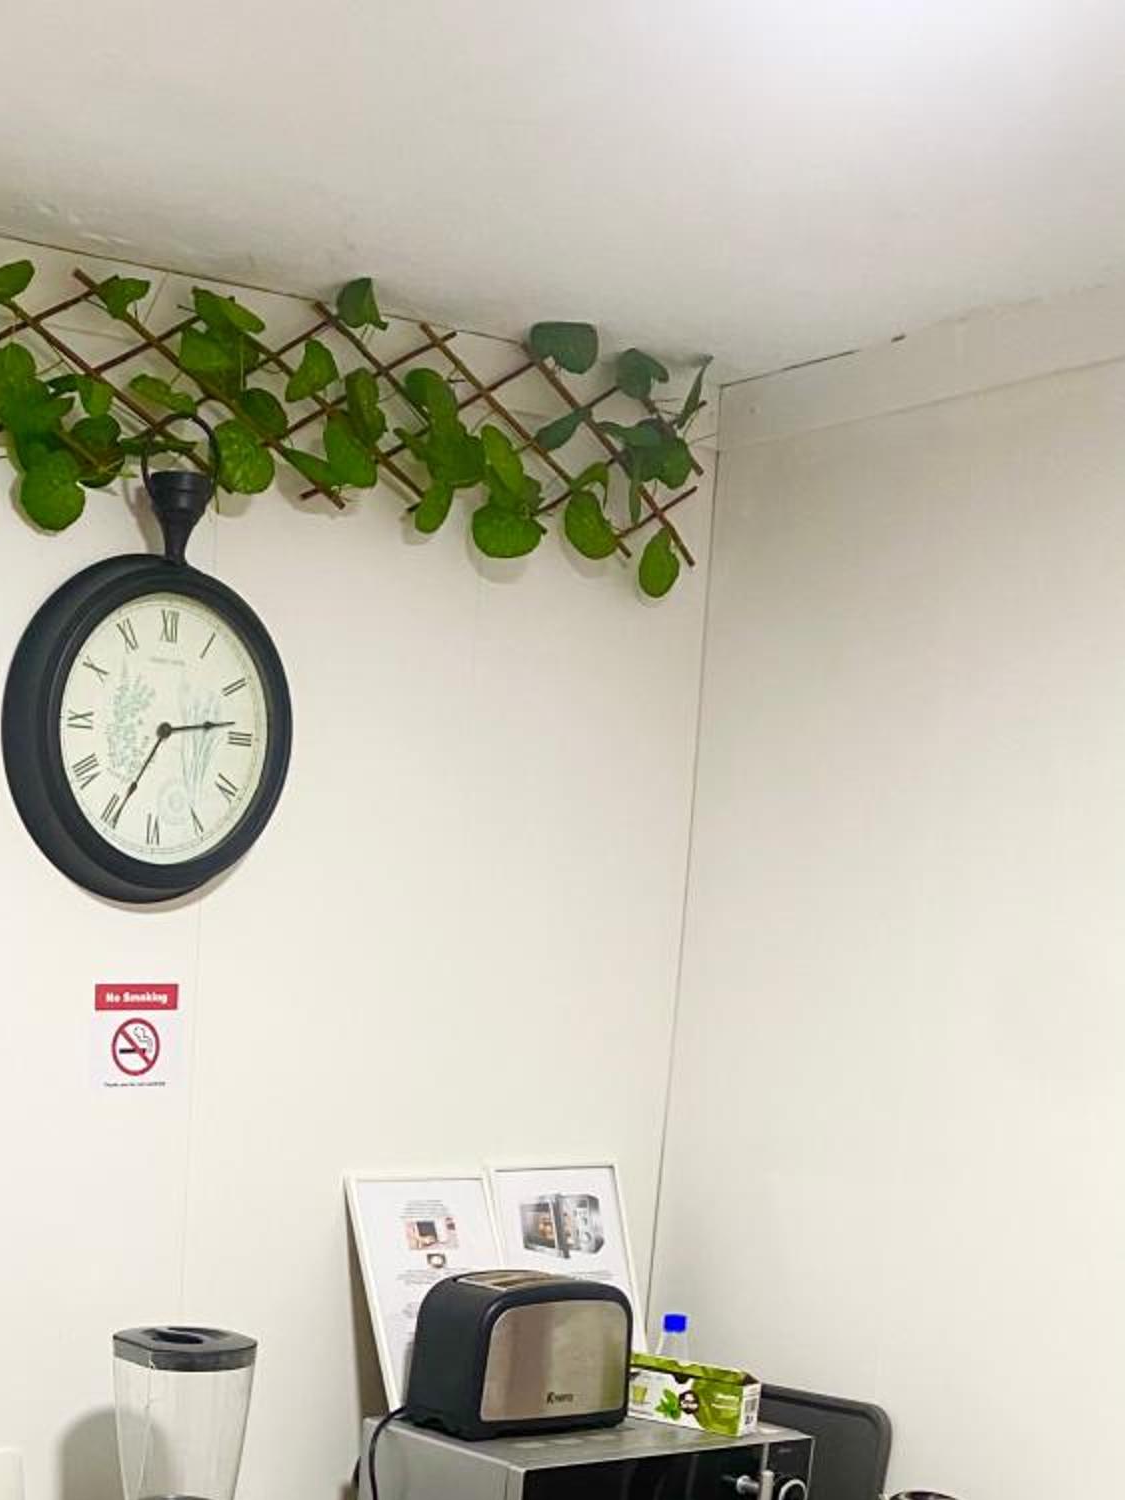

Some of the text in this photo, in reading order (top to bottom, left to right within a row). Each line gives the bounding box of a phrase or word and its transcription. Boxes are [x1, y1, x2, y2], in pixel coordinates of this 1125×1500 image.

[116, 617, 139, 654] XI
[159, 609, 179, 644] XII
[82, 655, 109, 687] X
[221, 677, 246, 697] II
[67, 709, 94, 730] IX
[227, 730, 253, 747] III
[106, 991, 168, 1005] No Smoking
